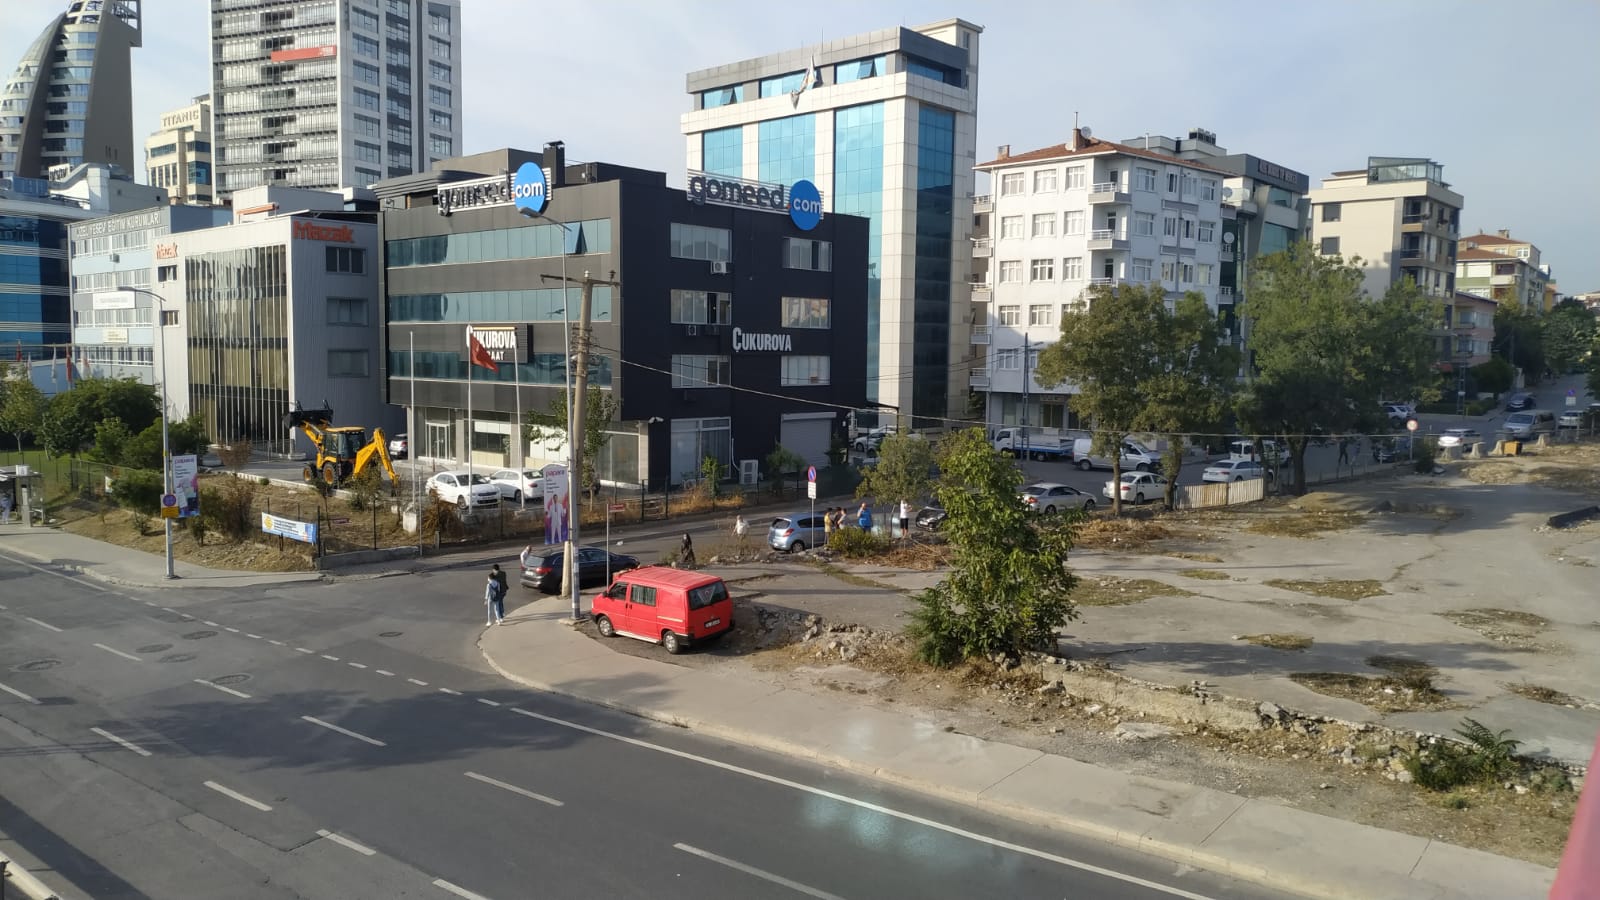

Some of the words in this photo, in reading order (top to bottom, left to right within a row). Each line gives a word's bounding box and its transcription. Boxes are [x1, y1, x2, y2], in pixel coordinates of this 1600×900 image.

[163, 109, 199, 127] TITANIC
[690, 176, 821, 214] gomeed.com
[732, 327, 792, 353] ÇUKUROVA
